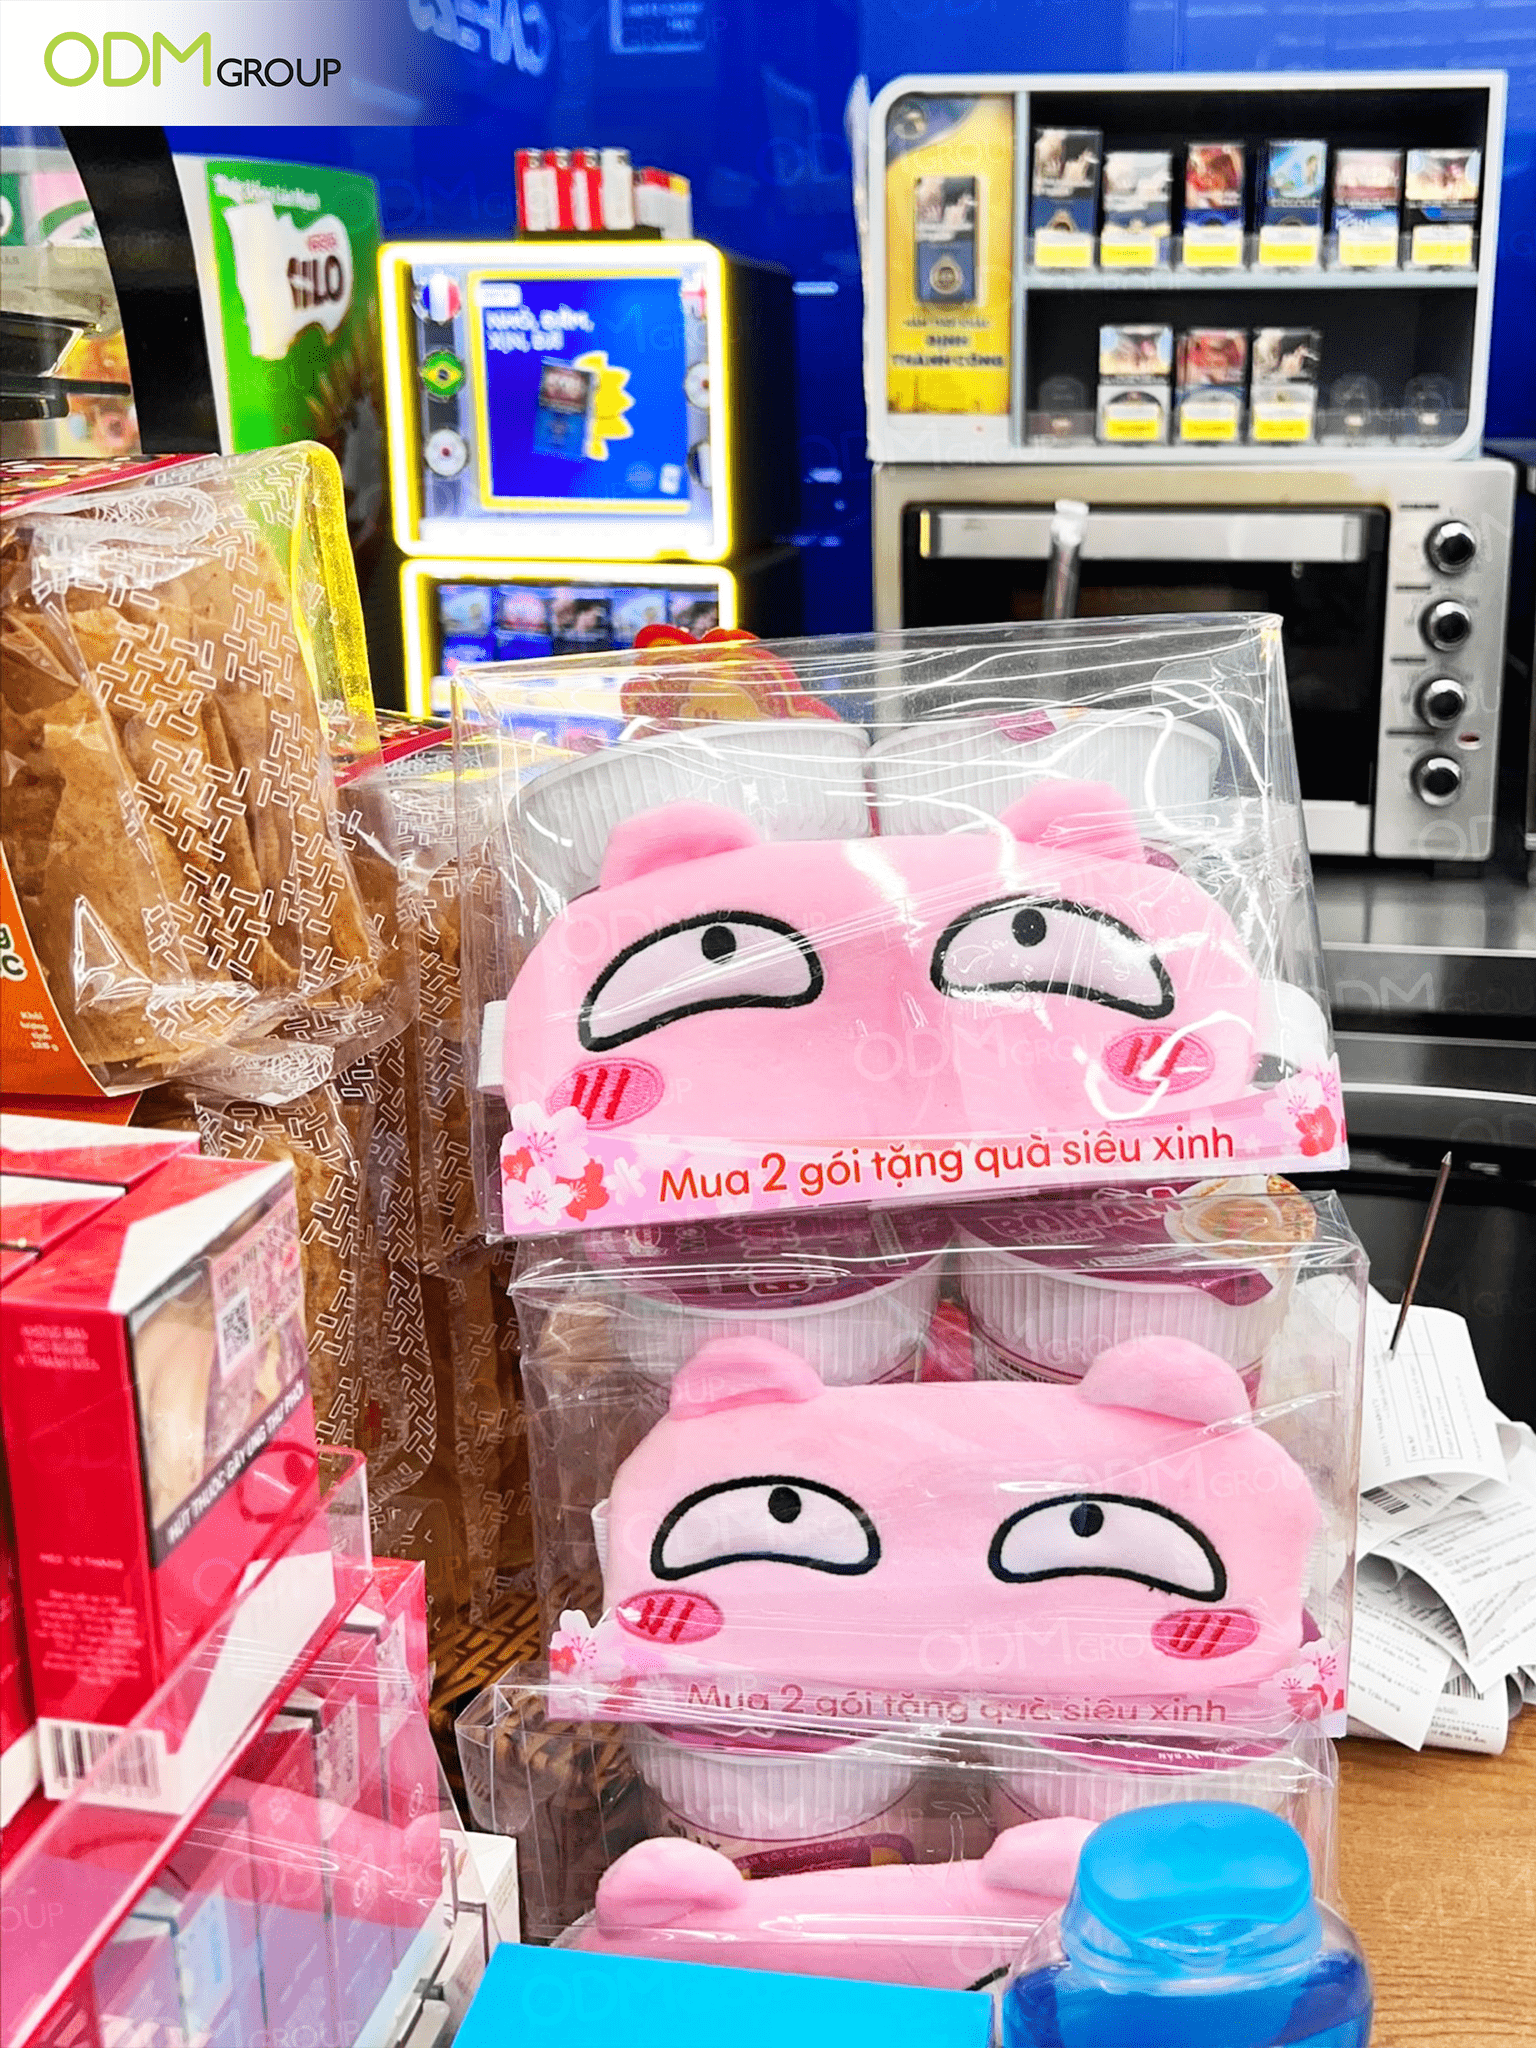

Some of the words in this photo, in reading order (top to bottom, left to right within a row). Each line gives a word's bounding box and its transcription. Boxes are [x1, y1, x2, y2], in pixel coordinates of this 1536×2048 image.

[659, 1168, 750, 1202] Mua
[761, 1152, 788, 1191] 2
[799, 1147, 861, 1197] gói
[872, 1142, 964, 1190] tặng
[974, 1133, 1051, 1174] quà
[1062, 1128, 1142, 1165] siêu
[1155, 1125, 1234, 1160] xinh
[688, 1683, 770, 1714] Mua
[780, 1683, 804, 1714] 2
[815, 1684, 874, 1719] gói
[884, 1686, 968, 1724] tặng
[1063, 1695, 1138, 1722] siêu
[1150, 1696, 1227, 1723] xinh
